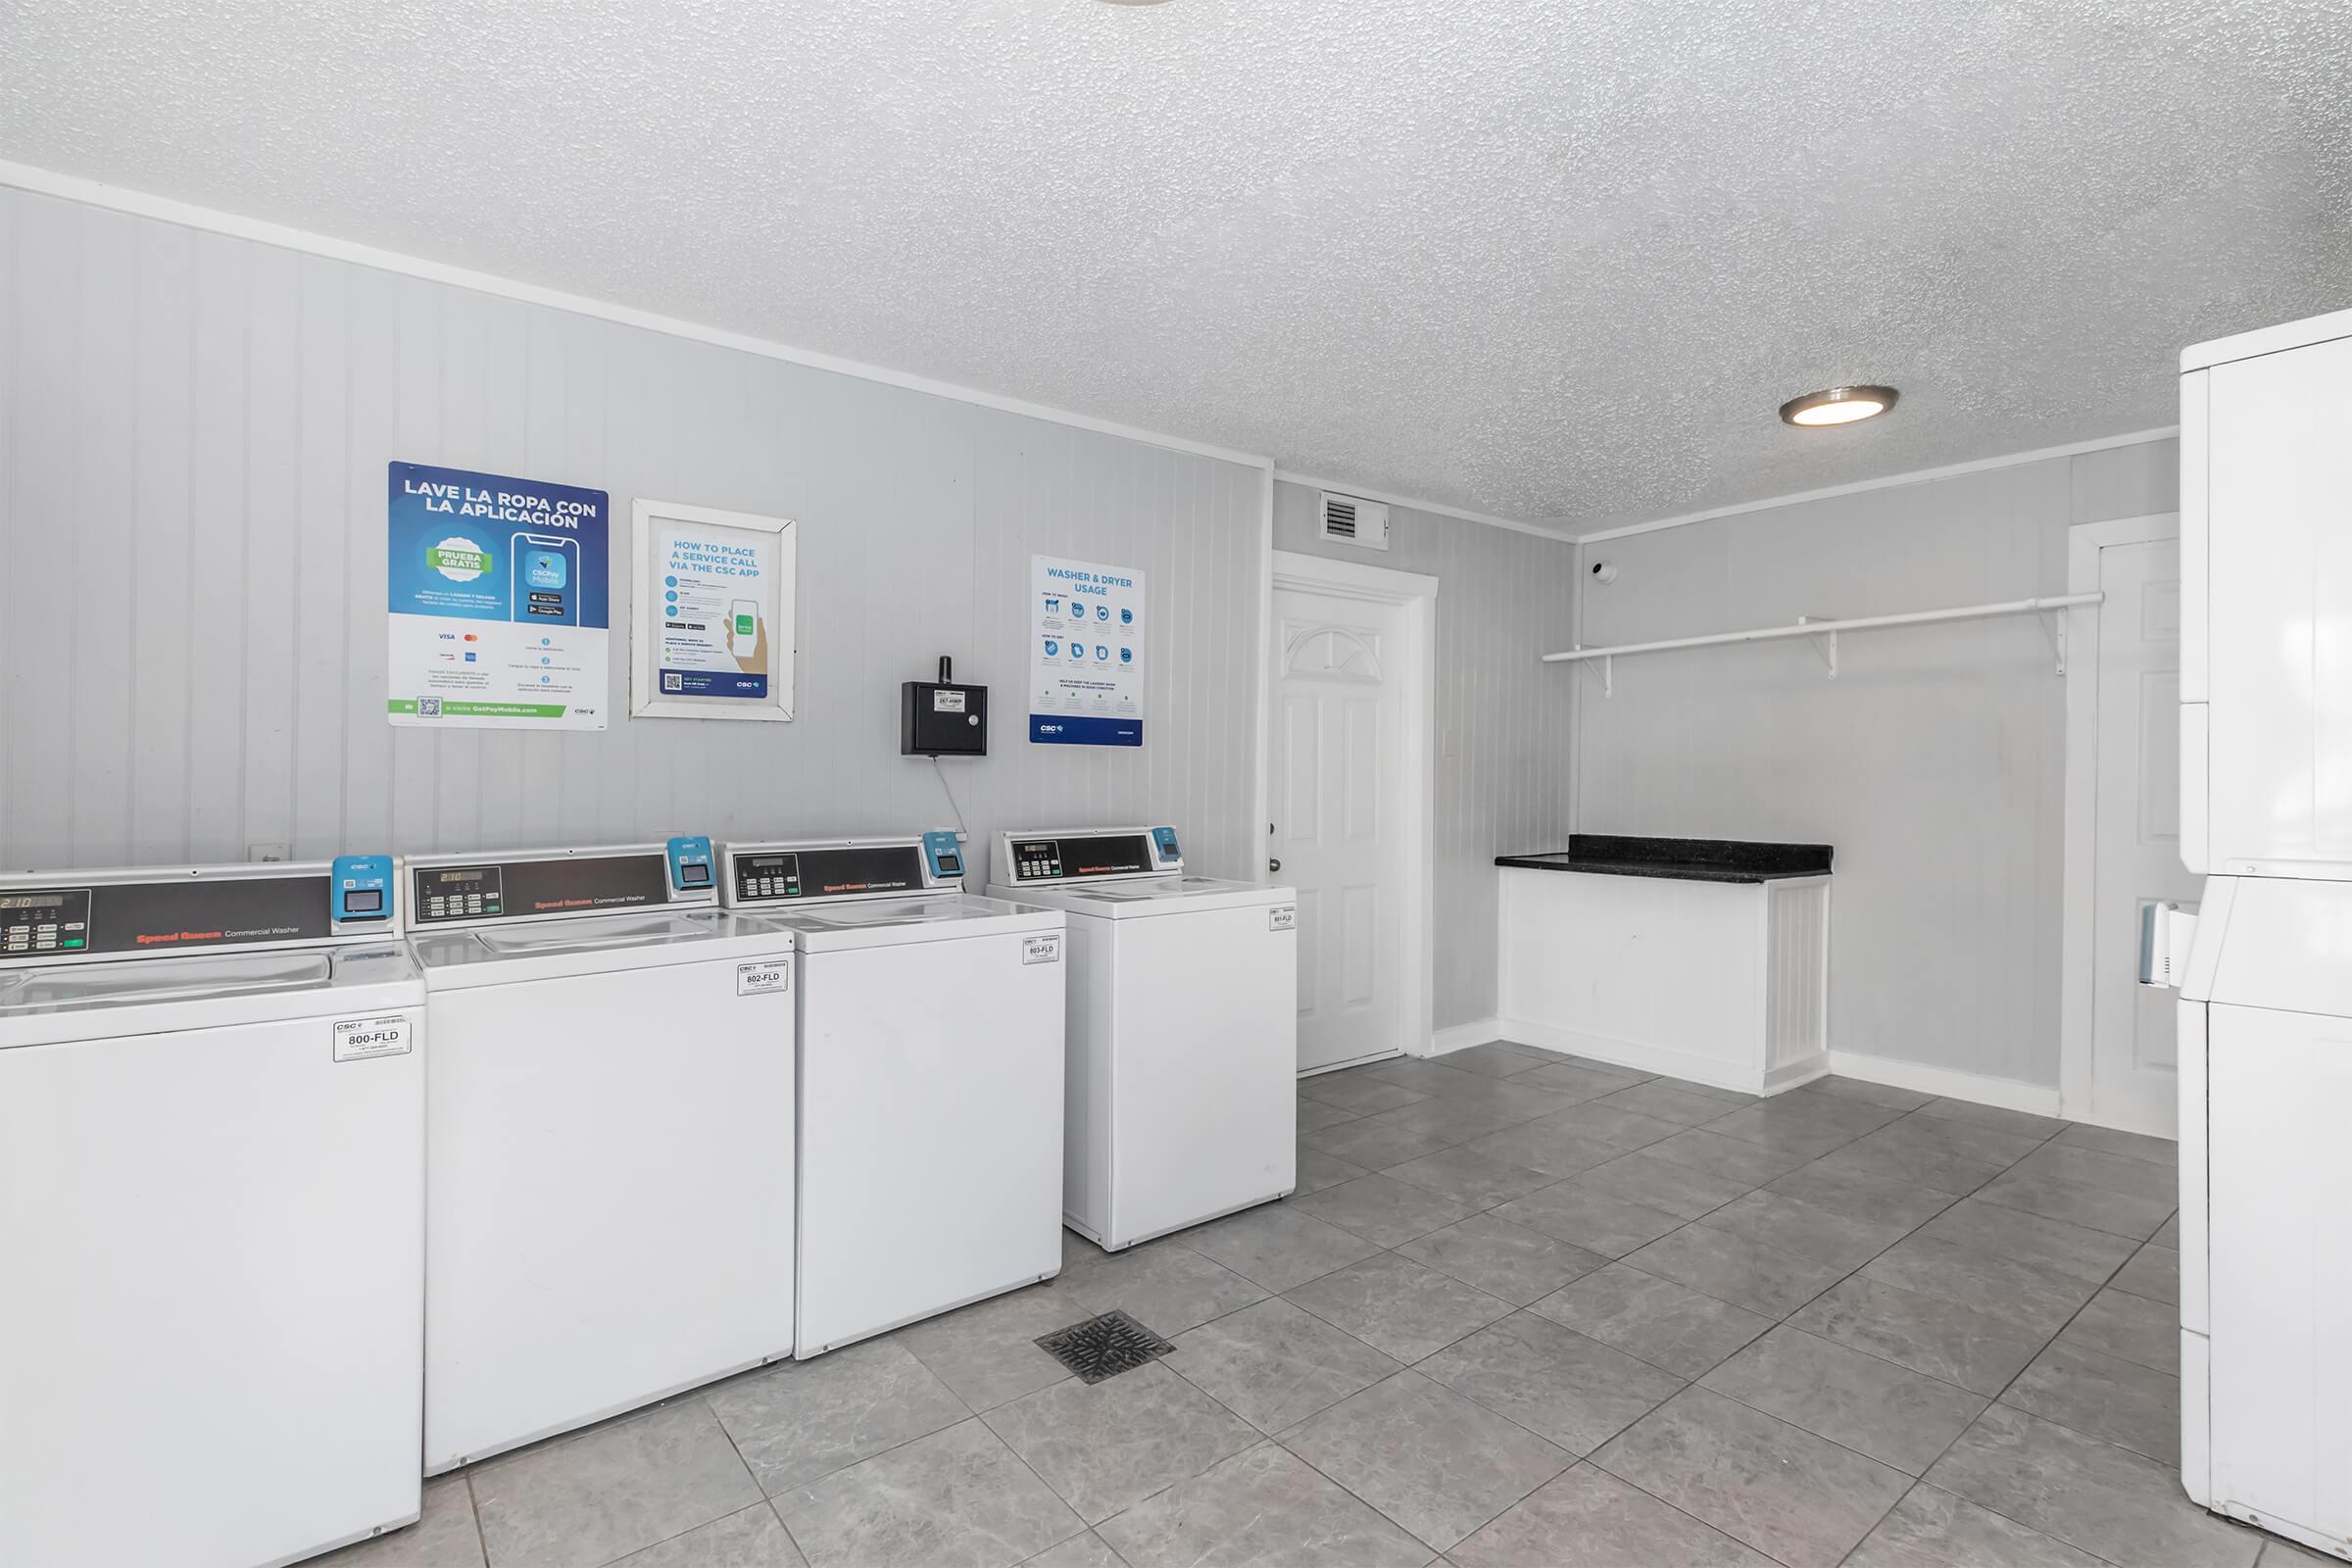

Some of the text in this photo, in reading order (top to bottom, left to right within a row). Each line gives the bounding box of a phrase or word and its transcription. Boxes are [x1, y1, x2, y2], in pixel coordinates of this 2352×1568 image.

[404, 479, 596, 517] LAVE LA ROPA CON
[425, 497, 578, 529] LA APLICACIÓN
[673, 540, 755, 557] HOW TO PLACE
[438, 551, 482, 563] PRUEBA
[442, 559, 481, 569] GRATIS
[682, 552, 727, 564] SERVICE
[730, 558, 758, 567] CALL
[669, 561, 760, 578] VIA THE CSC APP
[1048, 567, 1132, 588] WASHER & DRYER
[1074, 584, 1107, 596] USAGE
[472, 706, 538, 714] GetPayMobile.com
[534, 901, 564, 909] Speed
[136, 926, 300, 944] Speed Queen Commercial Washer
[1030, 945, 1054, 954] 803-FLD
[747, 972, 780, 983] 802-FLD
[348, 1031, 399, 1045] 800-FLD
